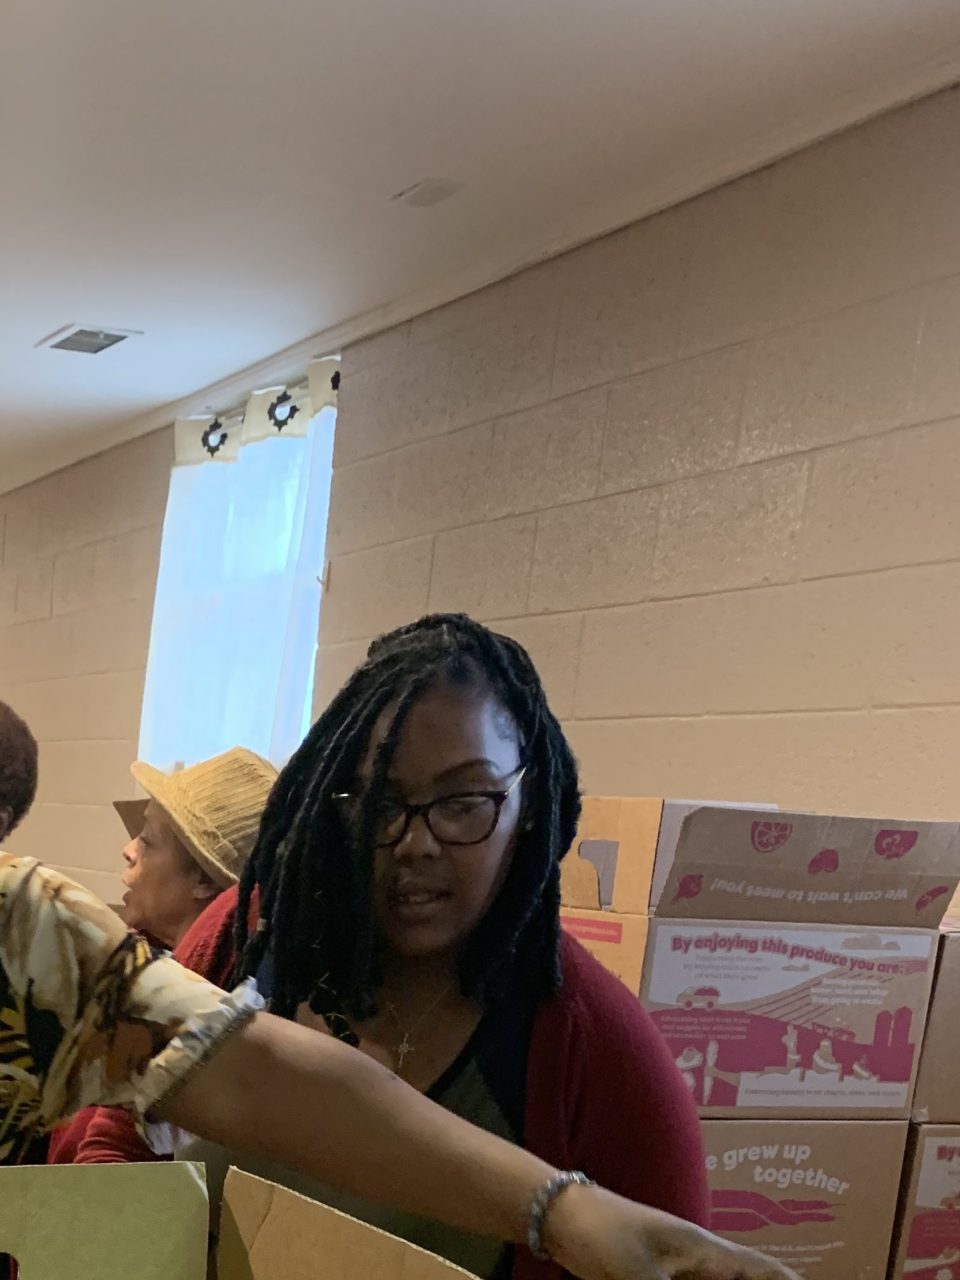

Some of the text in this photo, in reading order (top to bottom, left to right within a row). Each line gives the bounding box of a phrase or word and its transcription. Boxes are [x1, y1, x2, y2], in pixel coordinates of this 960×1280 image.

[746, 885, 785, 900] meet
[789, 888, 804, 901] to
[807, 889, 840, 904] wait
[671, 934, 691, 954] By
[694, 931, 758, 953] enjoying
[761, 936, 788, 955] this
[789, 943, 848, 966] produce
[849, 956, 875, 972] you
[877, 959, 904, 975] are:
[723, 1144, 780, 1171] grew
[783, 1144, 811, 1165] up
[753, 1165, 850, 1195] together
